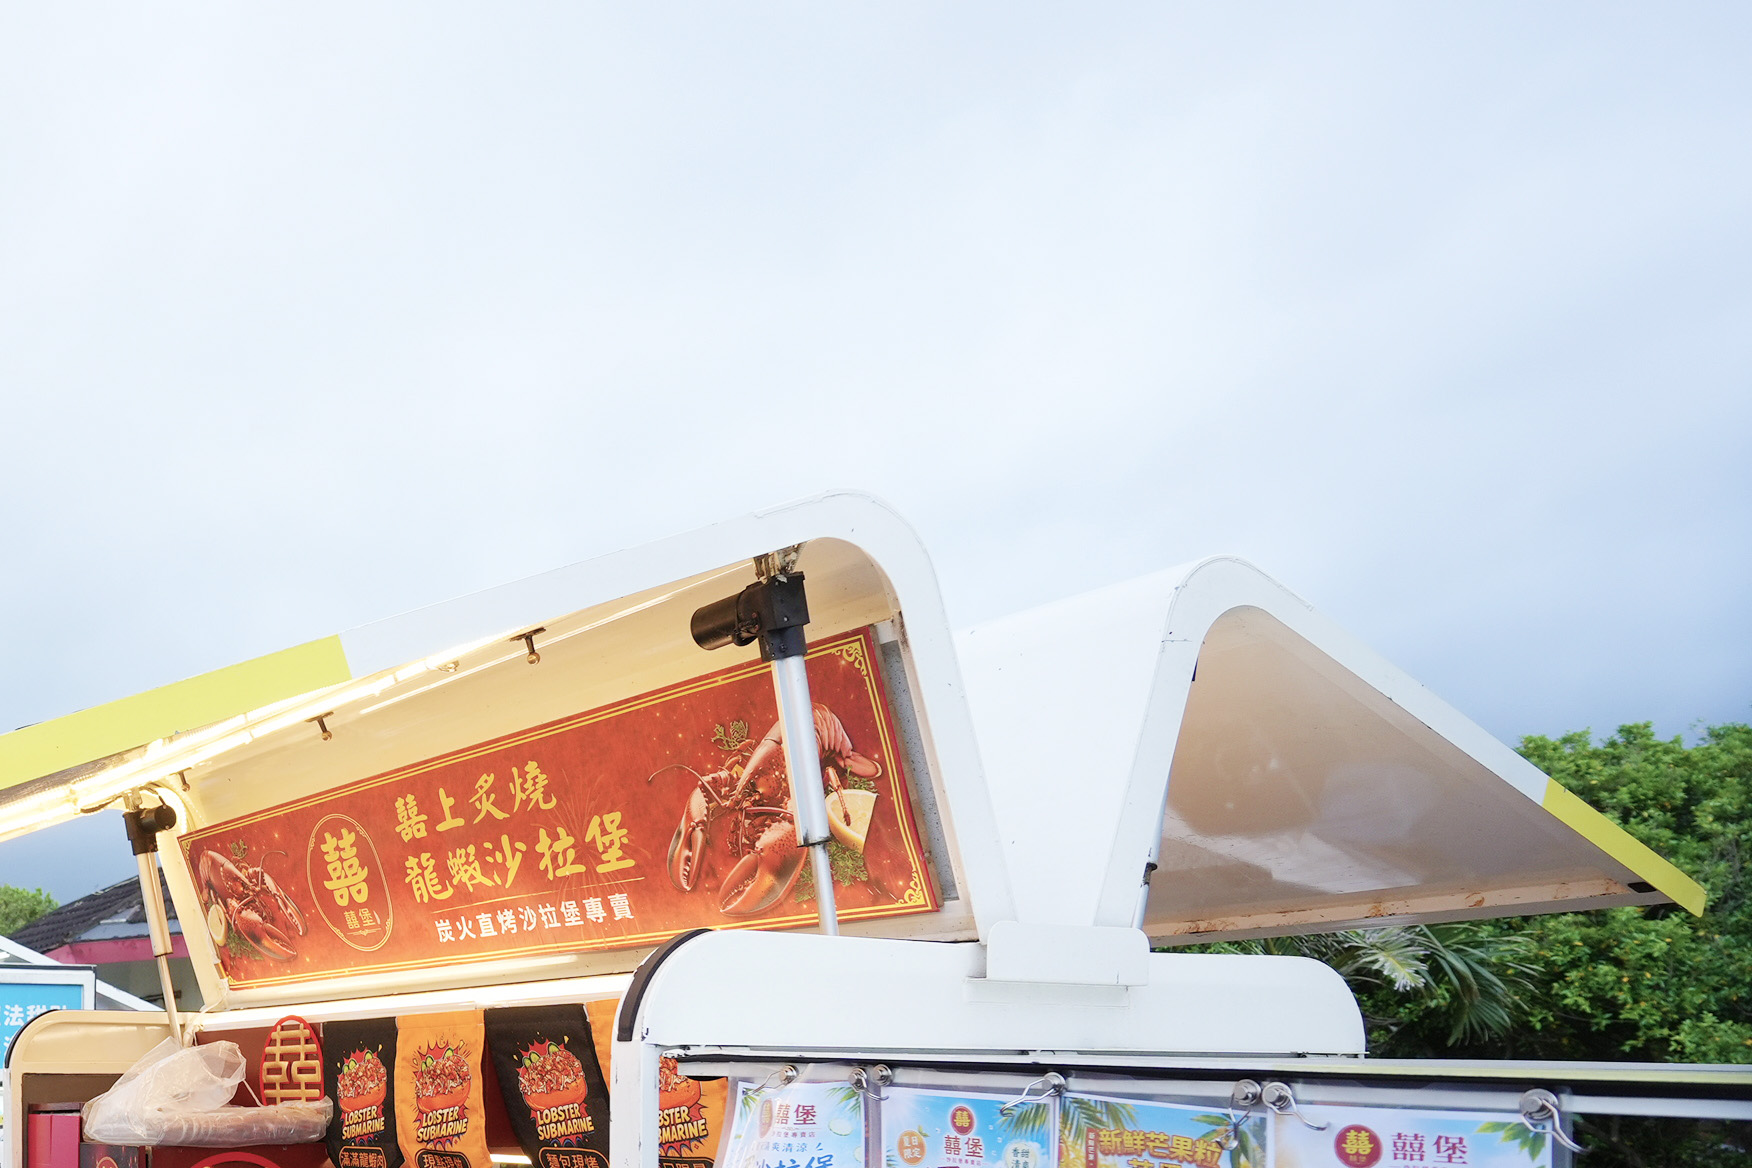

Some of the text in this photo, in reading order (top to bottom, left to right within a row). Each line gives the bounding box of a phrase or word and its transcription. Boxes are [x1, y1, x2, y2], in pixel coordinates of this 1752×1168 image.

[395, 761, 557, 842] 囍上炙燒
[321, 827, 368, 906] 囍
[405, 811, 635, 903] 龍蝦沙拉堡
[344, 908, 375, 930] 囍堡
[435, 893, 635, 942] 炭火直烤沙拉堡專賣
[345, 1105, 377, 1125] LOBSTER
[422, 1106, 460, 1124] LOBSTER
[537, 1103, 581, 1125] LOBSTER
[342, 1117, 385, 1140] SUBMARINE
[416, 1118, 468, 1142] SUBMARINE
[537, 1116, 595, 1141] SUBMARINE
[944, 1135, 984, 1158] 囍堡
[1392, 1132, 1469, 1165] 囍堡
[341, 1151, 384, 1168] 滿滿龍蝦肉
